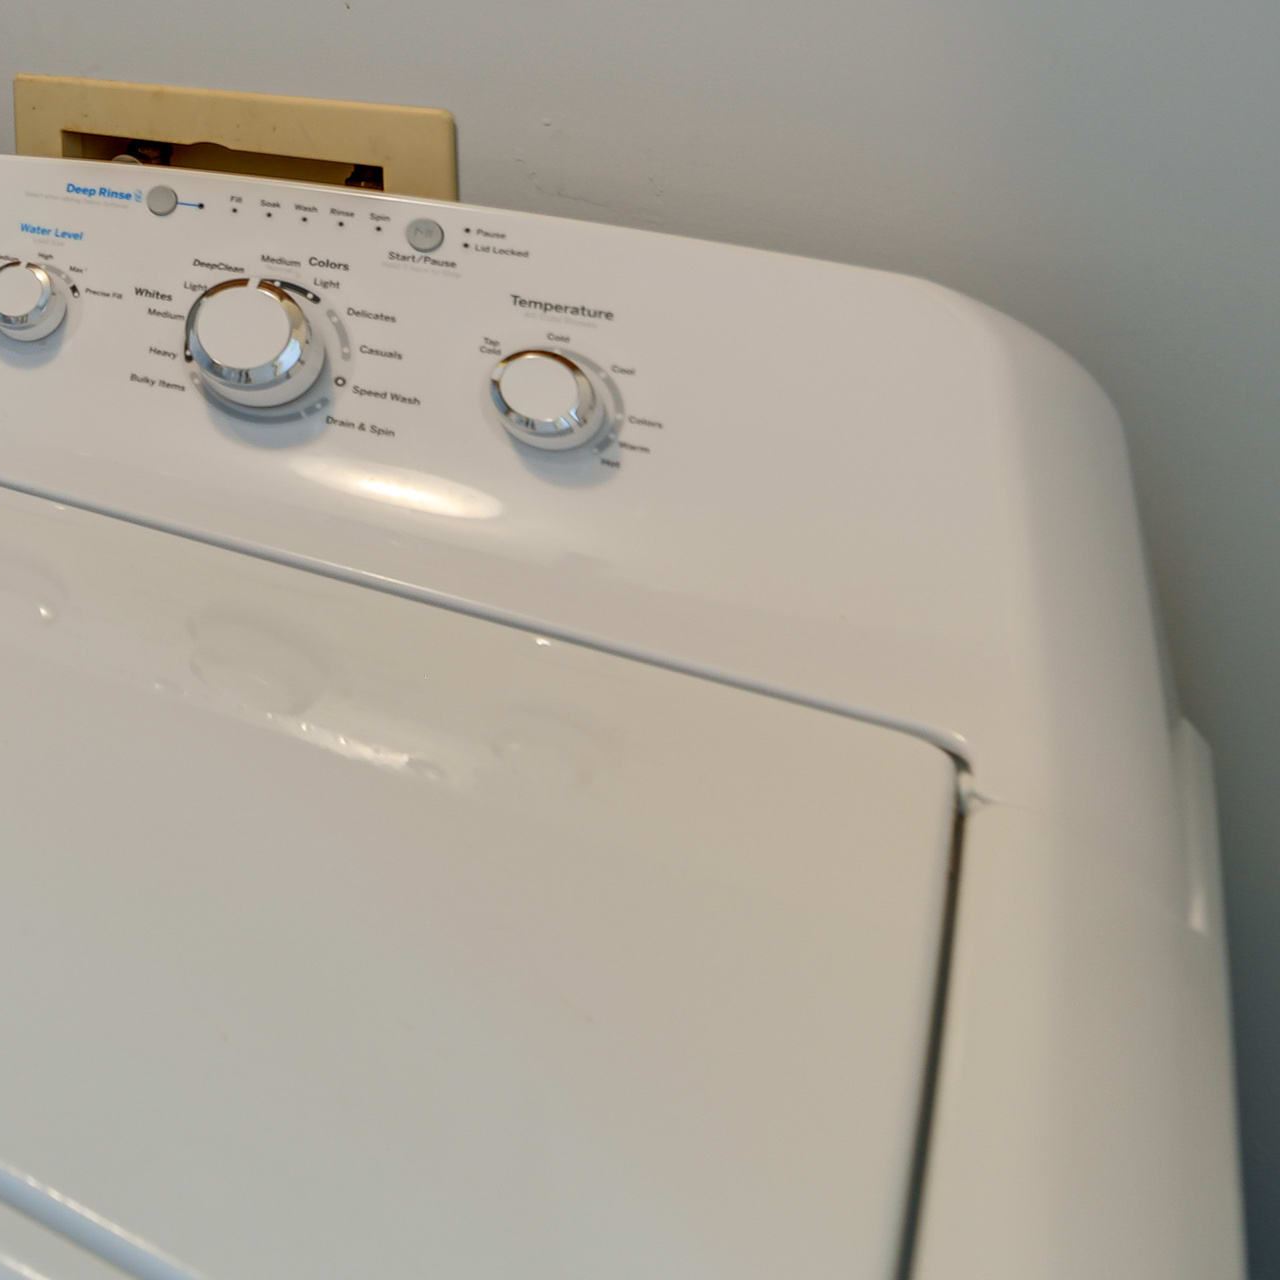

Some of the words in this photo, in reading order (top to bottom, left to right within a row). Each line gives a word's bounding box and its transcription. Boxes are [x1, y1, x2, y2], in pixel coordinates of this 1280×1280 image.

[66, 183, 96, 197] Deep
[99, 187, 132, 200] Rinse
[230, 195, 242, 204] Fill
[260, 199, 281, 209] Soak
[294, 203, 318, 214] Wash
[330, 208, 355, 218] Rinse
[370, 212, 390, 223] Spin
[20, 223, 52, 236] Water
[55, 228, 83, 240] Level
[476, 229, 506, 240] Pause
[38, 252, 54, 261] High
[475, 244, 490, 254] Lid
[492, 246, 529, 258] Locked
[192, 258, 245, 273] DeepClean
[261, 254, 301, 268] Medium
[308, 257, 350, 271] Colors
[389, 251, 457, 269] Start/Pause
[184, 281, 209, 293] Light
[313, 277, 340, 290] Light
[85, 288, 110, 298] Precise
[112, 291, 123, 299] Fill
[134, 286, 173, 302] Whites
[147, 307, 185, 321] Medium
[511, 294, 614, 321] Temperature
[346, 307, 397, 323] Delicates
[483, 336, 500, 347] Tap
[547, 332, 570, 343] Cold
[149, 345, 178, 360] Heavy
[359, 344, 403, 360] Casuals
[479, 346, 502, 356] Cold
[130, 373, 157, 388] Bulky
[159, 379, 186, 392] Items
[352, 385, 388, 401] Speed
[390, 391, 421, 406] Wash
[326, 415, 355, 430] Drain
[358, 422, 368, 432] &
[369, 424, 396, 438] Spin
[628, 415, 663, 429] Colors
